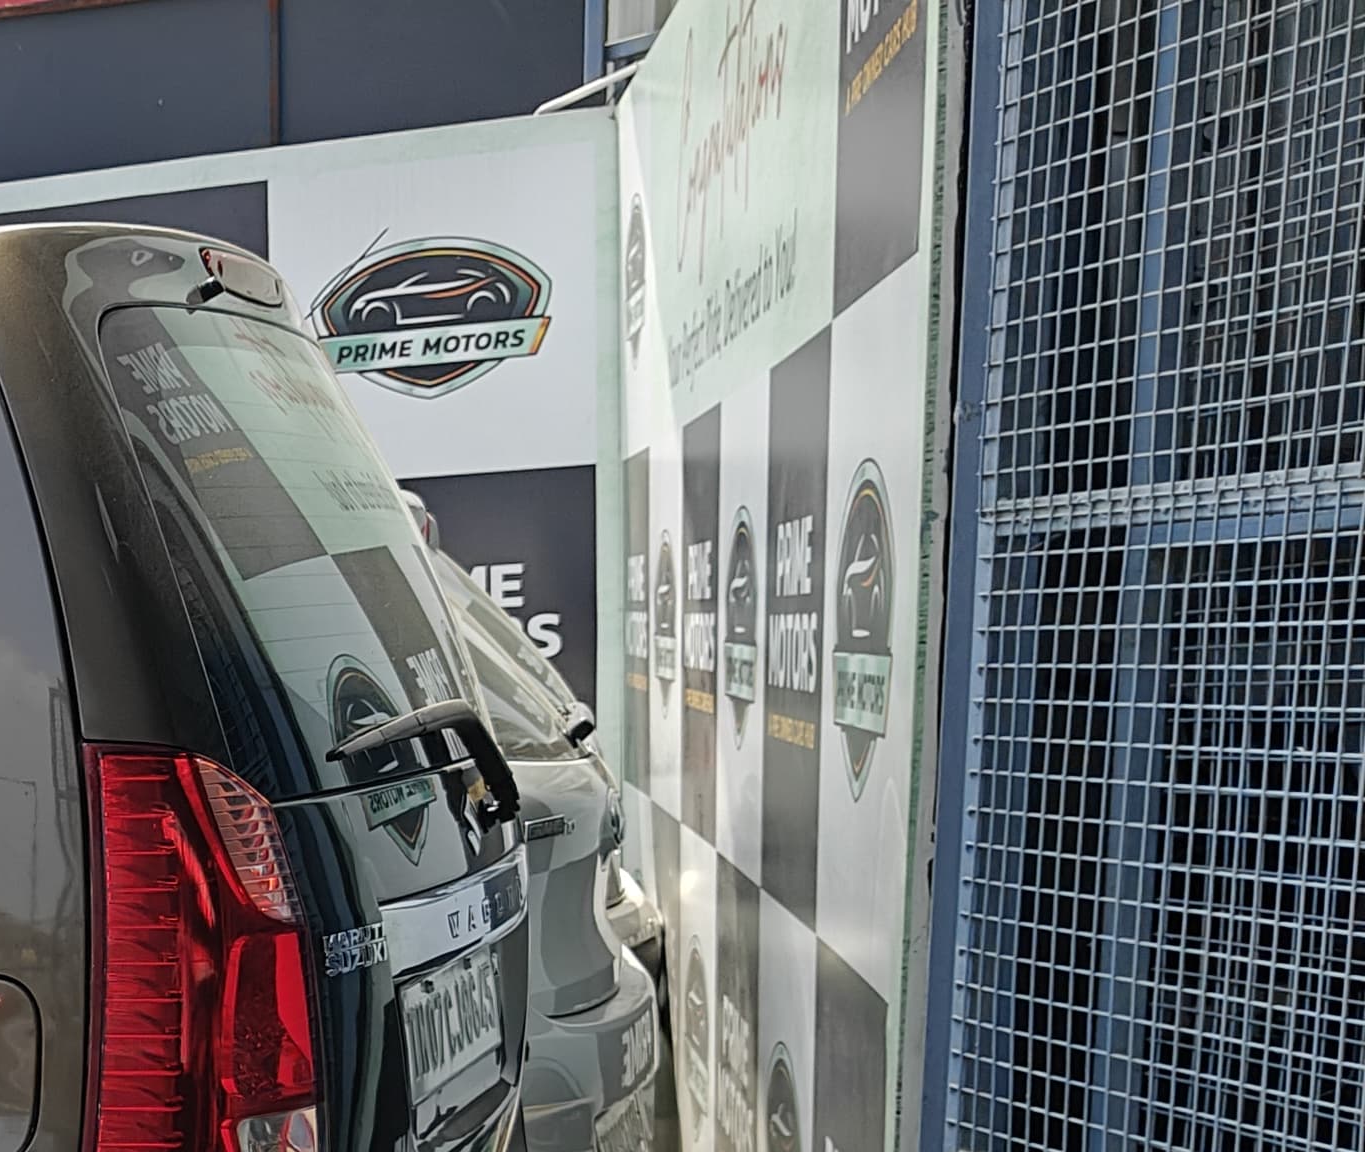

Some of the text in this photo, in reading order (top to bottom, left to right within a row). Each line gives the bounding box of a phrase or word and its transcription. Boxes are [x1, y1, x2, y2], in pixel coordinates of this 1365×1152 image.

[336, 329, 525, 364] PRIME MOTORS
[776, 515, 814, 597] PRIME
[769, 612, 818, 693] MOTORS
[325, 941, 388, 977] SUZUKI
